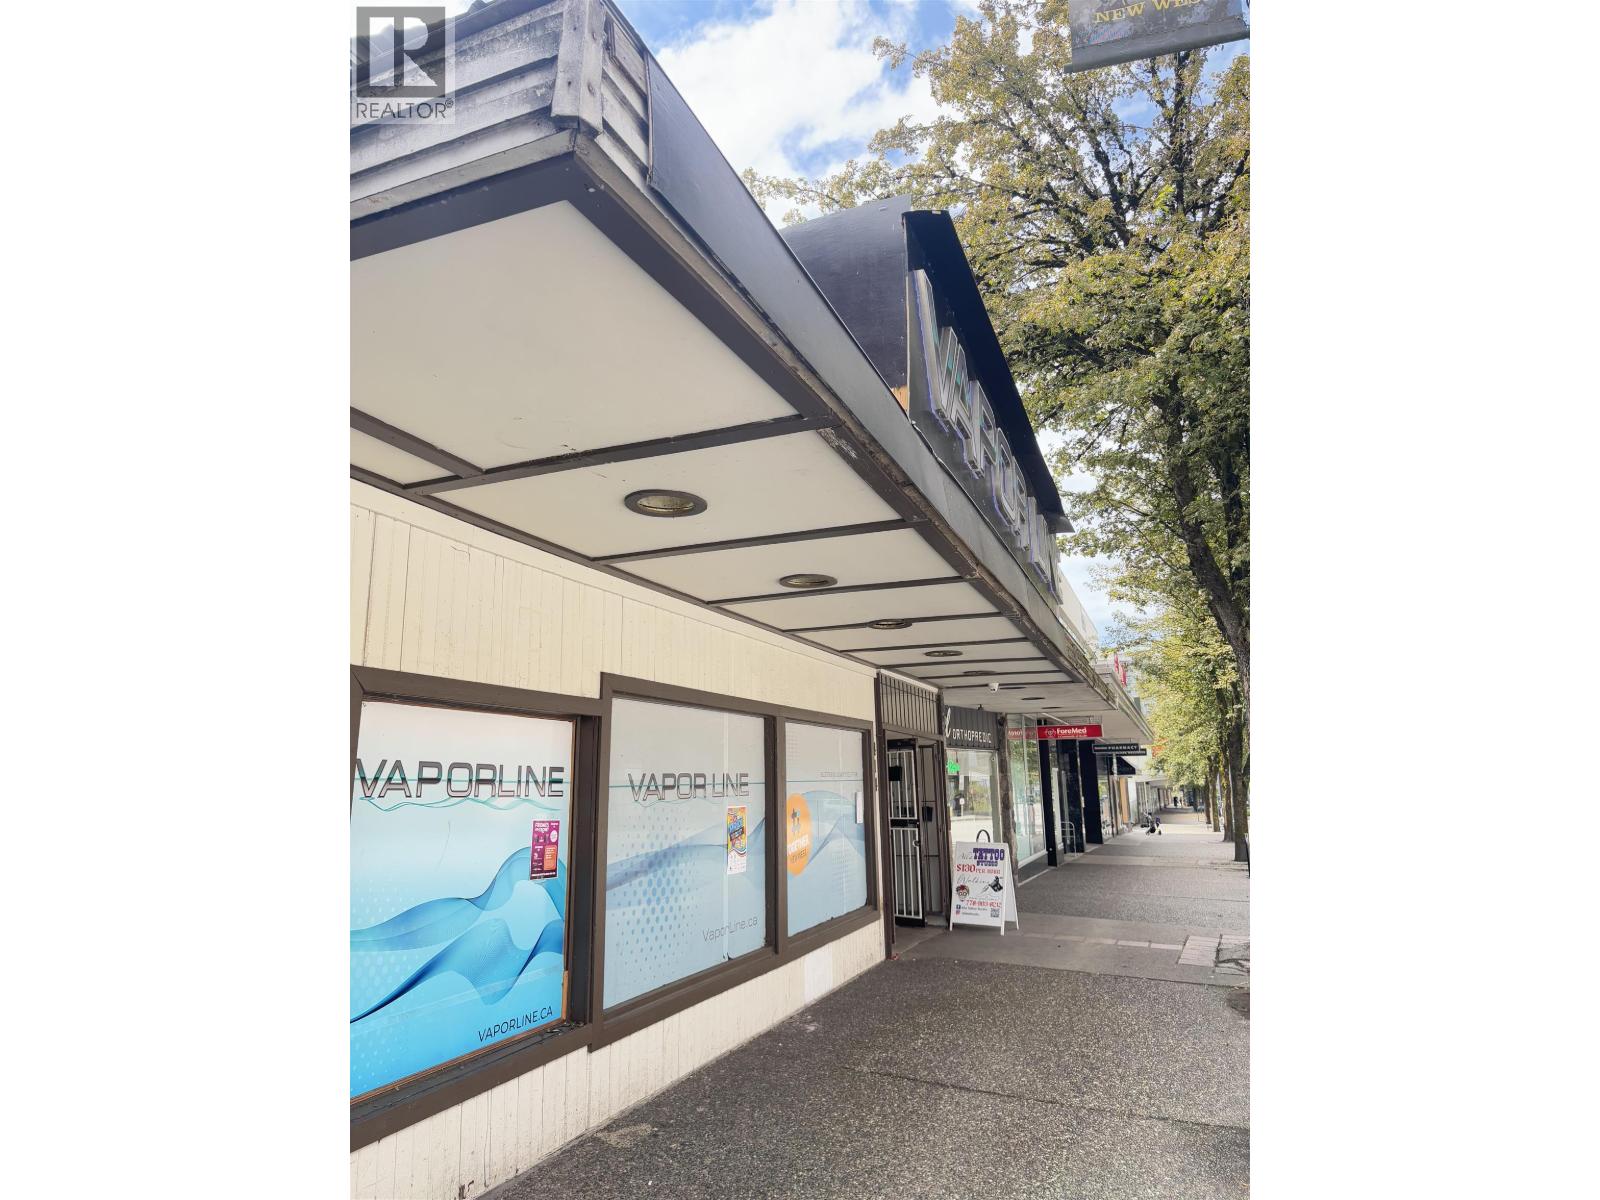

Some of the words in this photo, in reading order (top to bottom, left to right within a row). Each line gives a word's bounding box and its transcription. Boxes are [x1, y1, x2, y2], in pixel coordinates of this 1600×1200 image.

[1094, 2, 1146, 23] NEW
[356, 758, 565, 799] VAPORLINE
[627, 772, 707, 802] VAPOR
[712, 772, 750, 798] LINE
[972, 848, 1005, 860] TATTOO
[478, 1006, 553, 1043] VAPORLINE.CA
